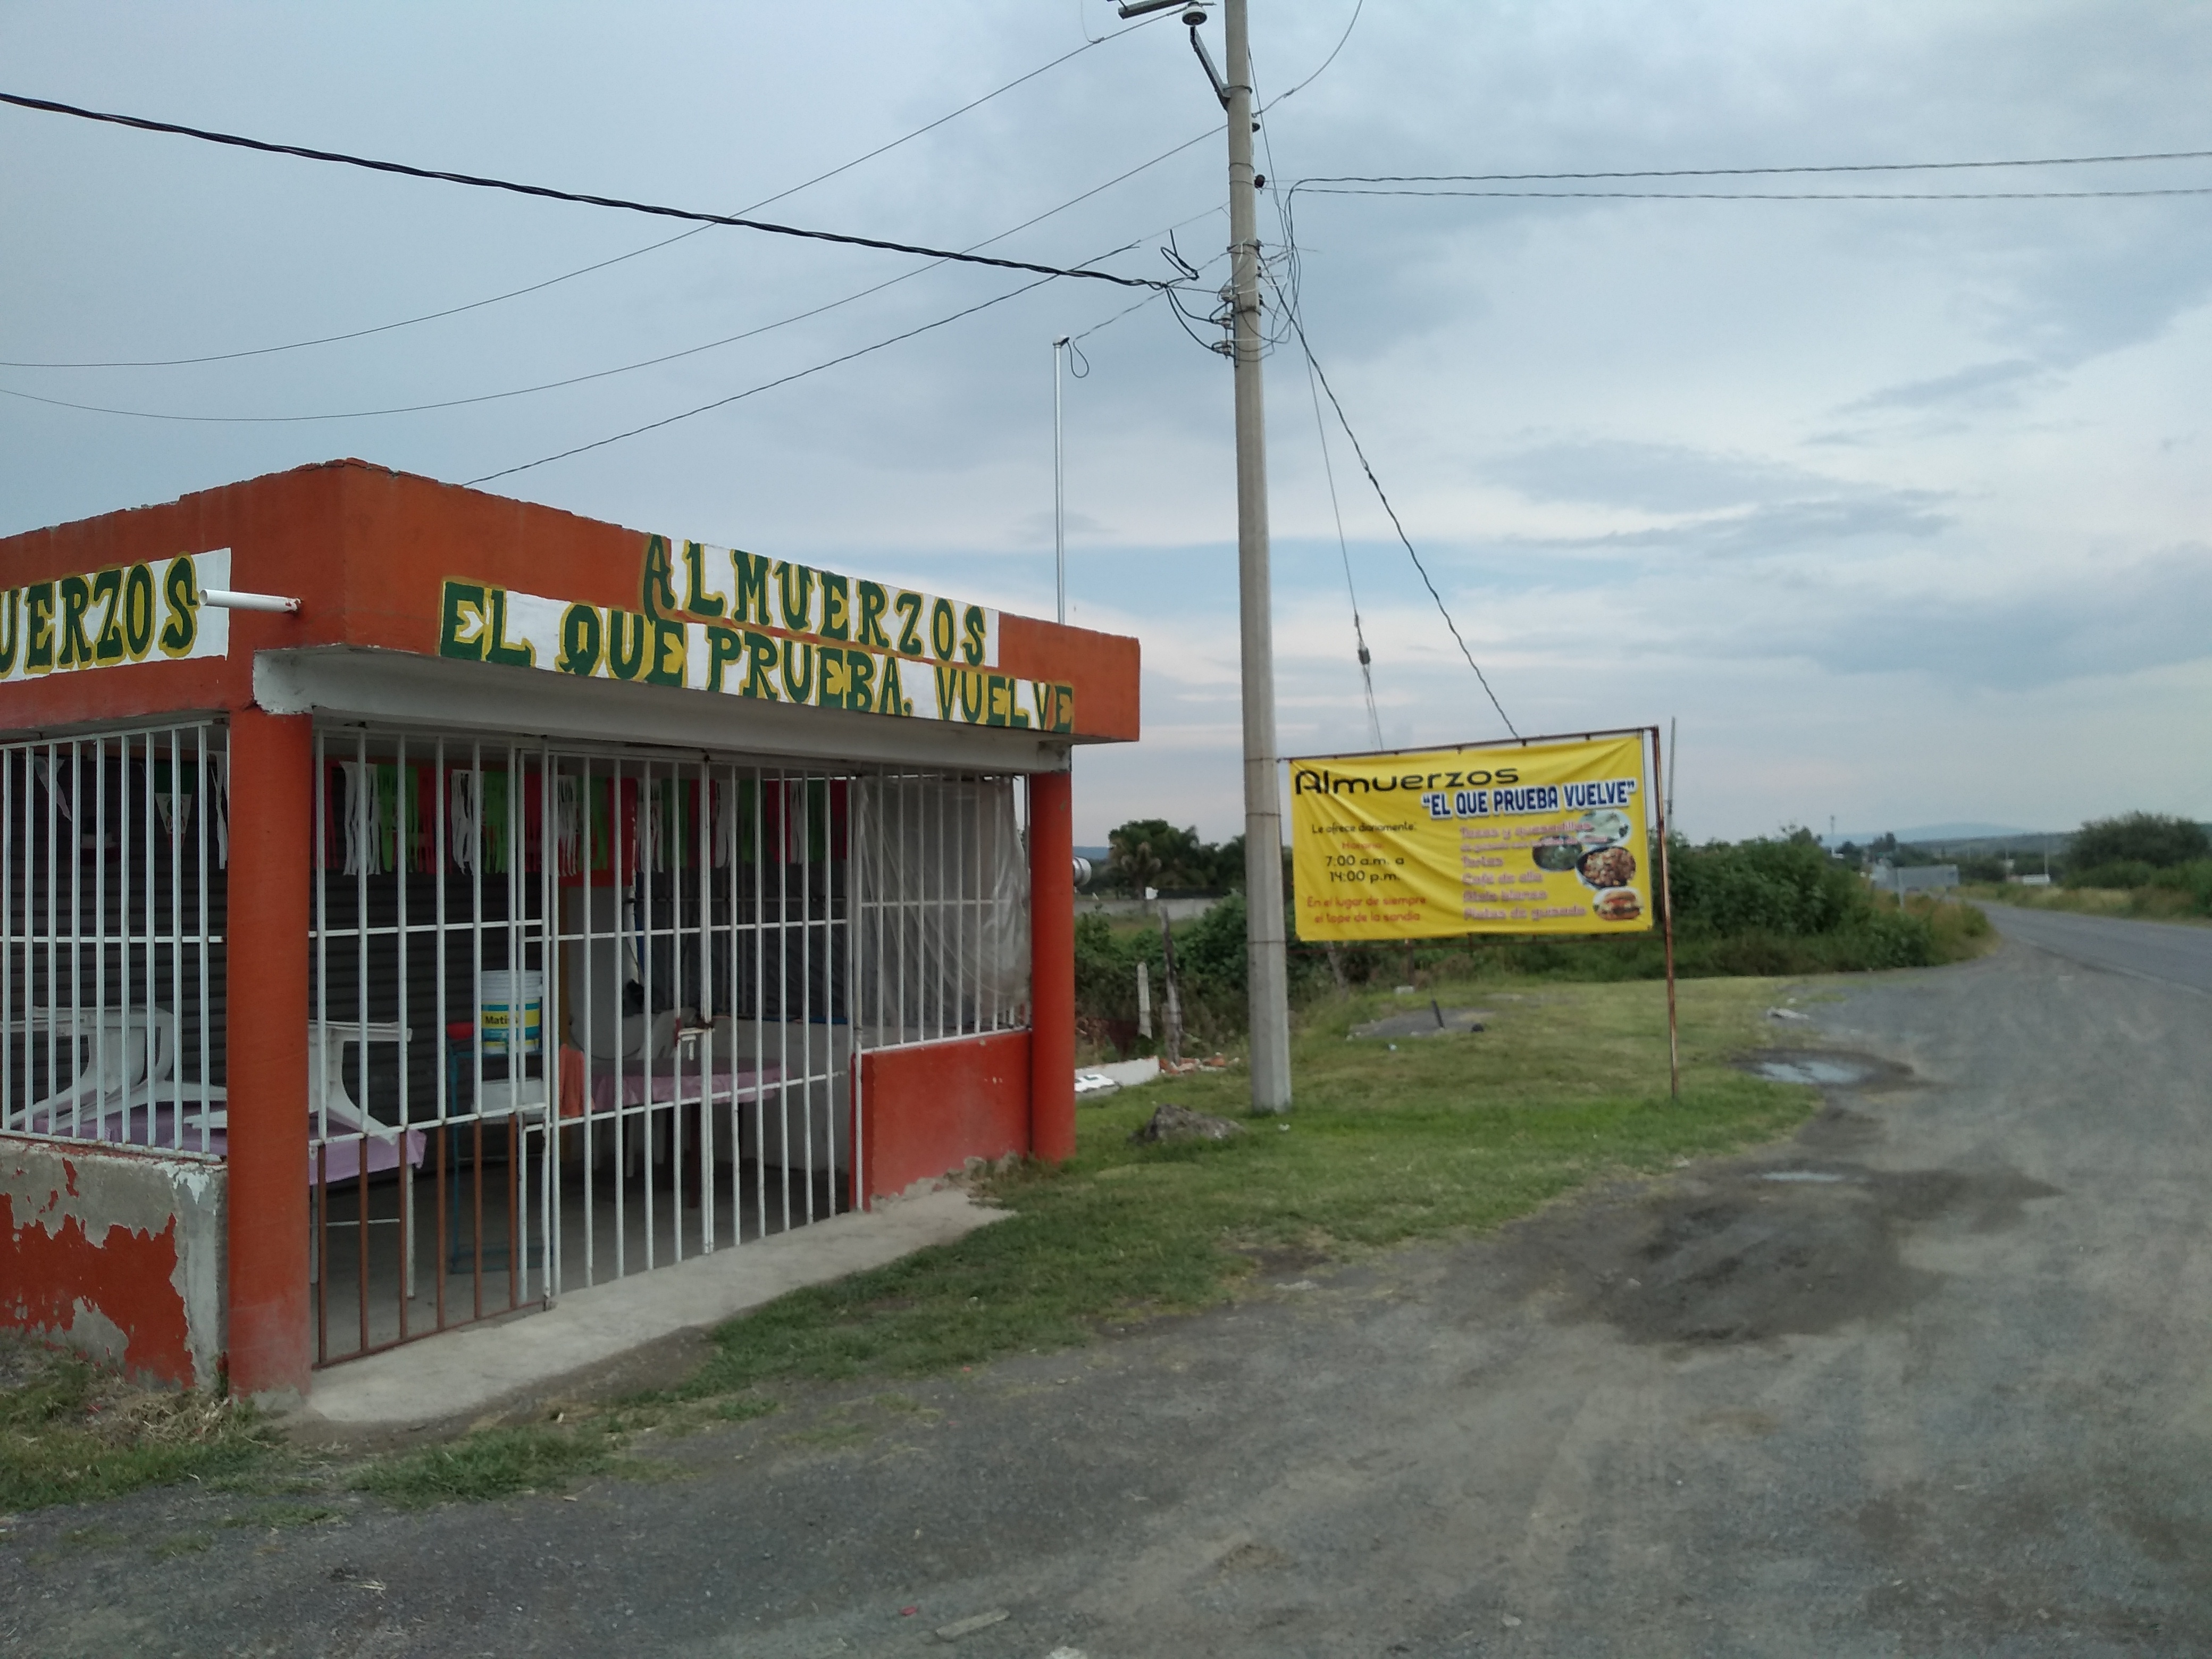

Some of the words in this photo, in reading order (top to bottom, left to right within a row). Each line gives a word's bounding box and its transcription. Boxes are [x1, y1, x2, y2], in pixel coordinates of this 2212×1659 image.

[642, 533, 986, 667] ALMUERZOS
[439, 580, 533, 668] EL
[558, 604, 685, 688] QUE
[934, 664, 1074, 735] VUELVE
[1295, 767, 1520, 795] Almuerzos
[1456, 791, 1488, 815] QUE
[1493, 785, 1559, 812] PRUEBA
[1312, 824, 1324, 834] Le
[1395, 857, 1405, 865] a
[1370, 873, 1401, 884] p.m.
[1307, 896, 1321, 908] En
